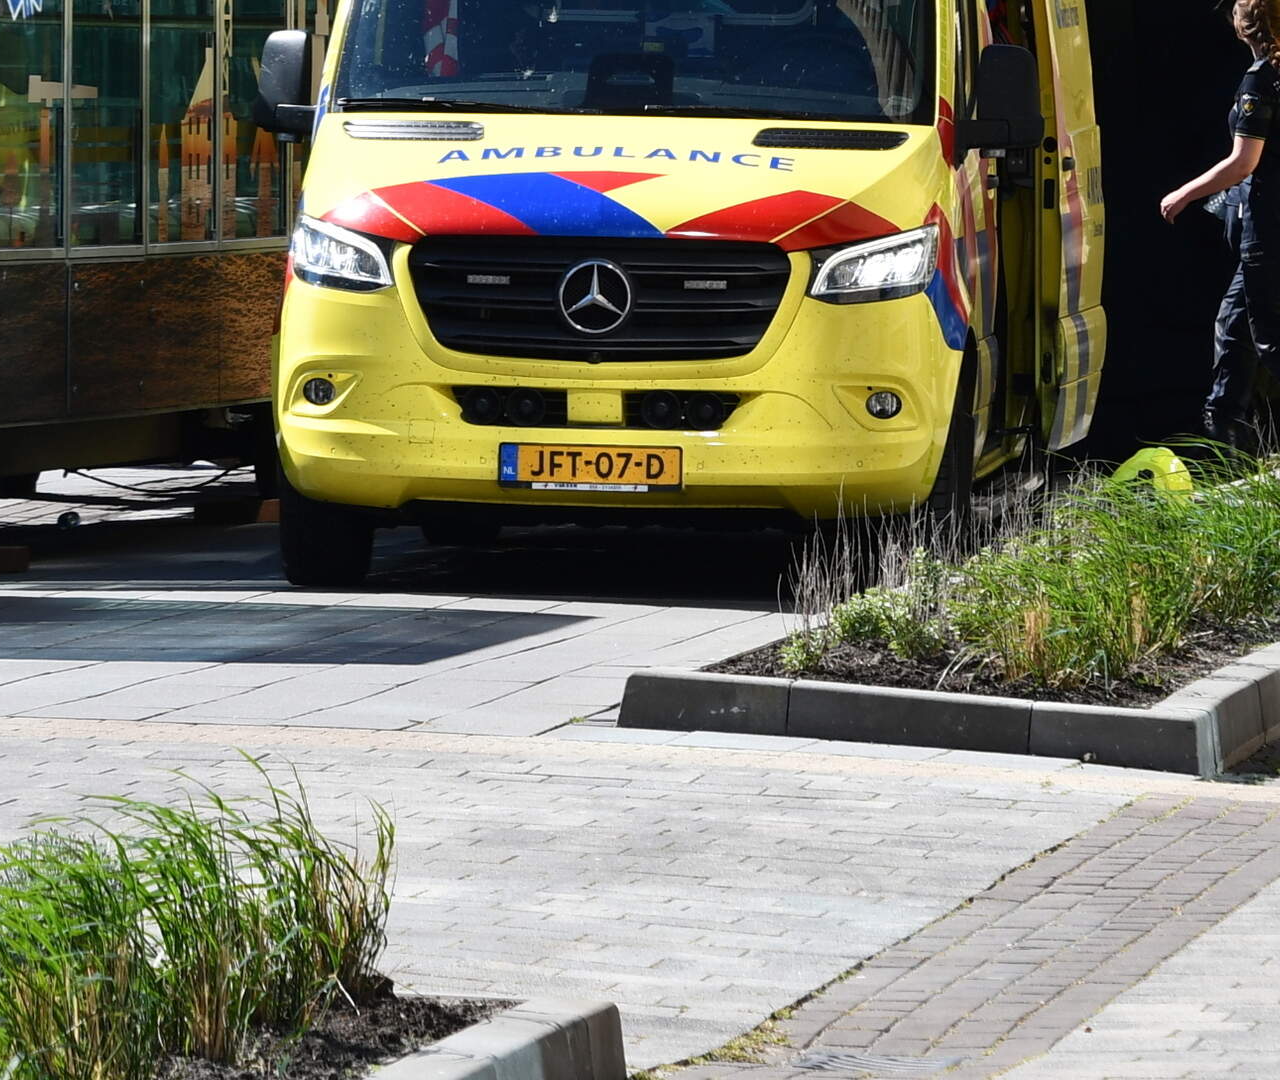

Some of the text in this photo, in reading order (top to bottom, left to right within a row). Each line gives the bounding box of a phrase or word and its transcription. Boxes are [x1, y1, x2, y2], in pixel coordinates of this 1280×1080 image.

[437, 146, 795, 172] AMBULANCE
[503, 466, 516, 475] NL
[531, 450, 665, 480] JFT-07-D
